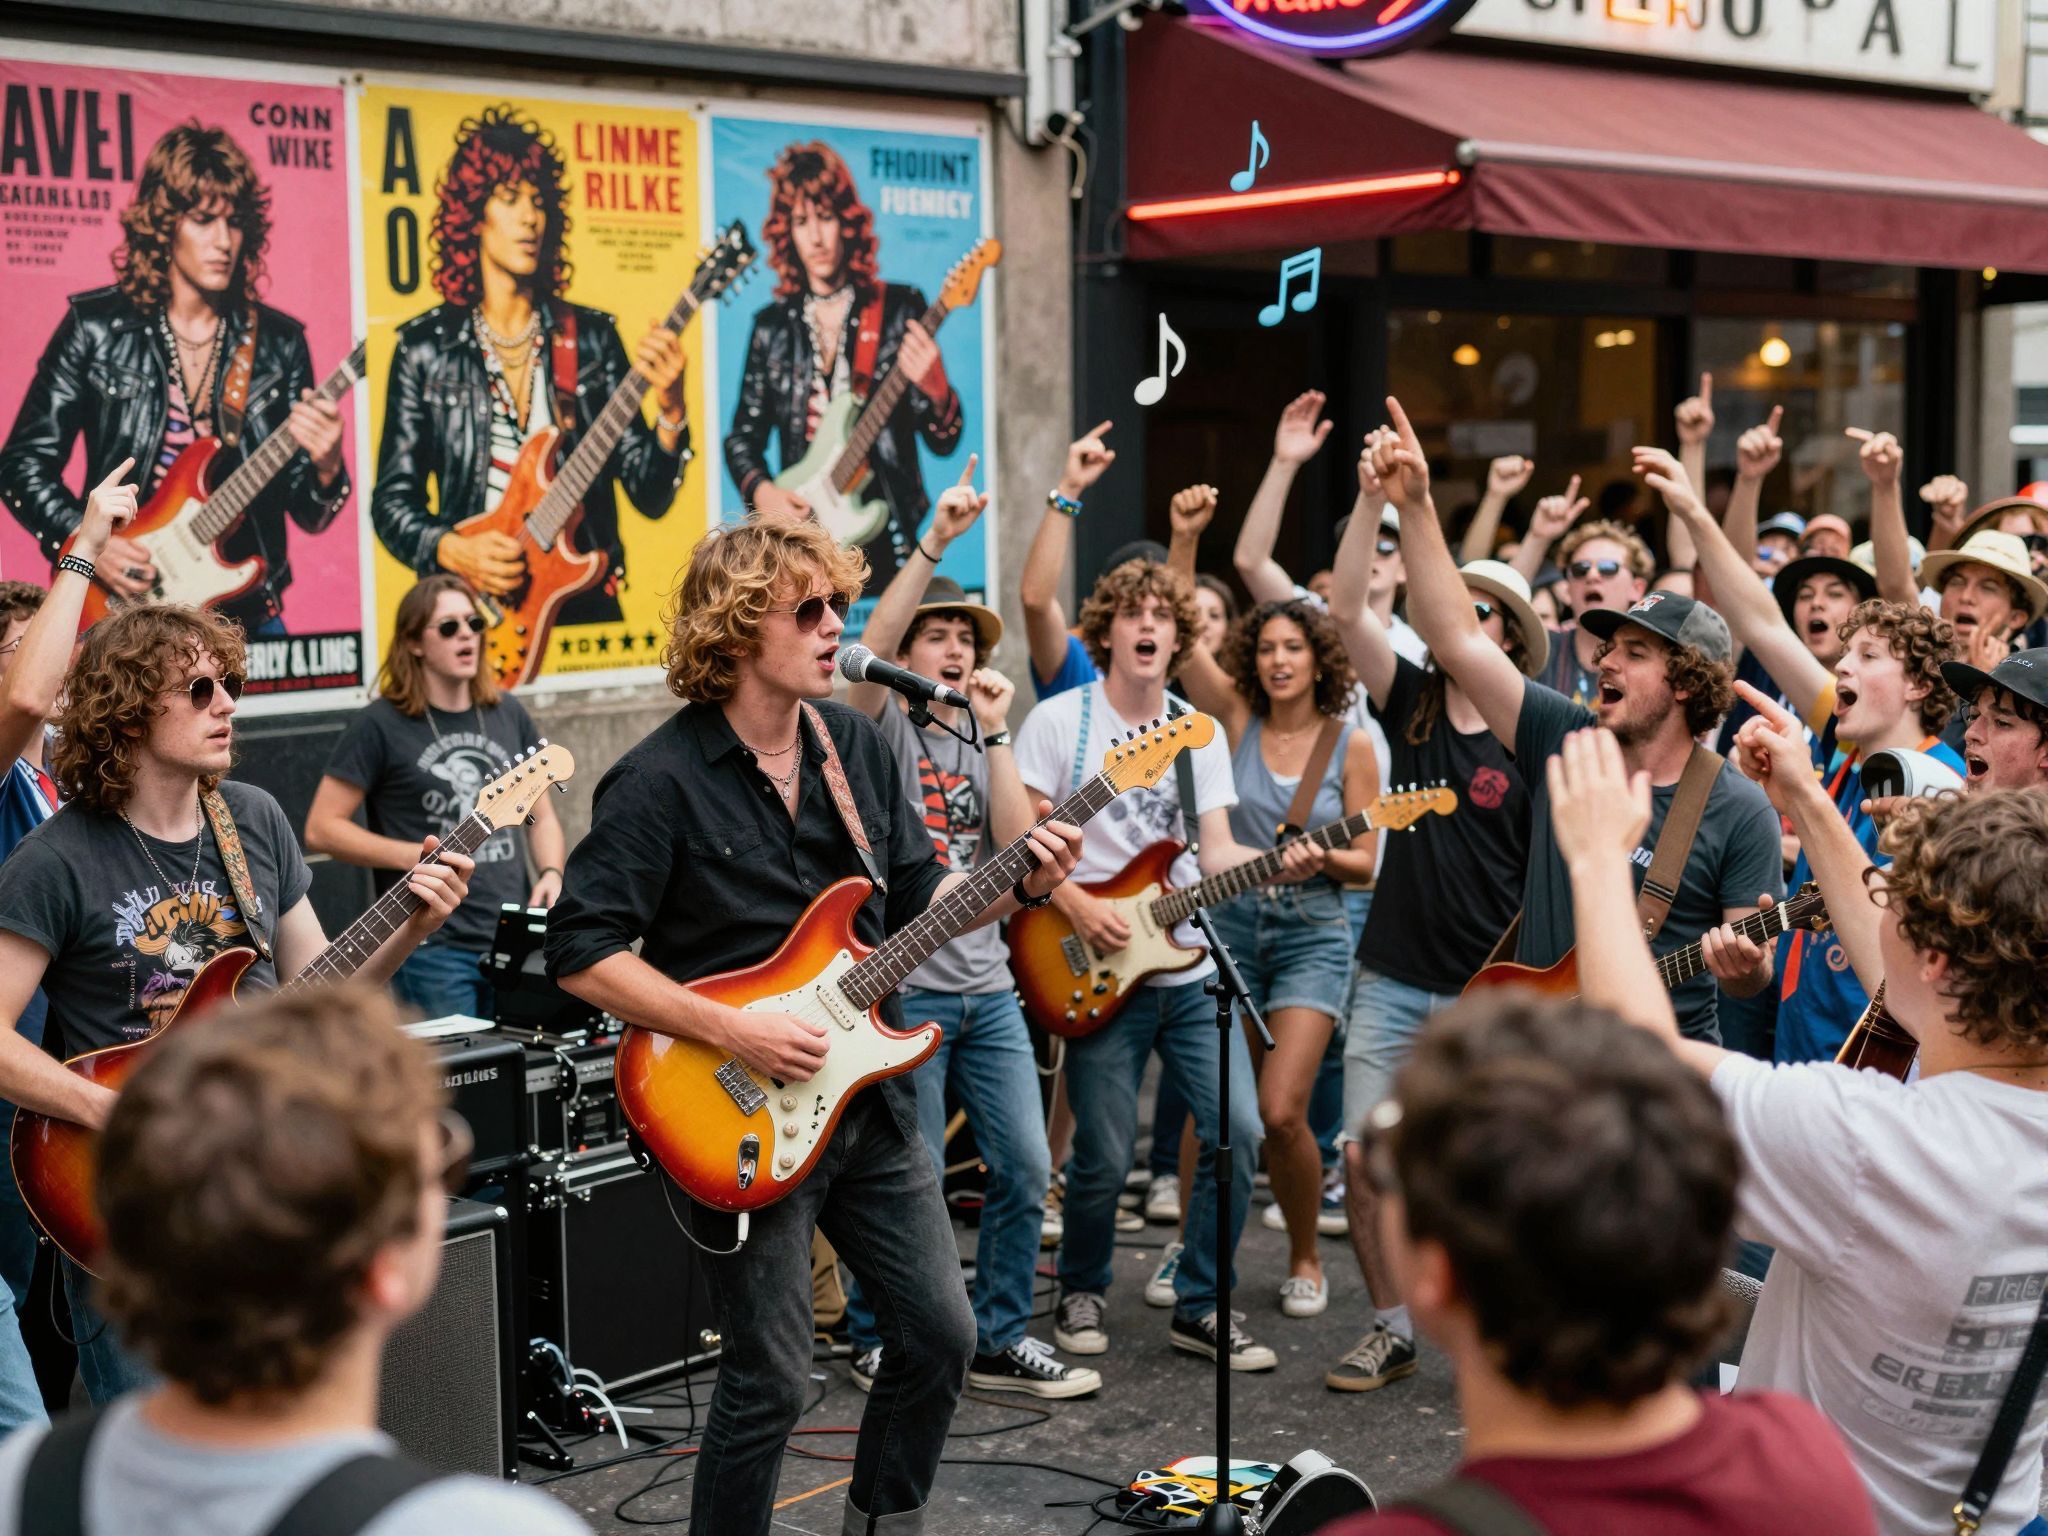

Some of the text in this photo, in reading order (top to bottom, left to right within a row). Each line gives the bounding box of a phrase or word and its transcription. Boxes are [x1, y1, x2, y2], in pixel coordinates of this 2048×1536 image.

[1, 83, 136, 183] AVEI
[250, 102, 332, 132] CONN
[268, 136, 334, 171] WIKE
[585, 171, 684, 215] RILKE
